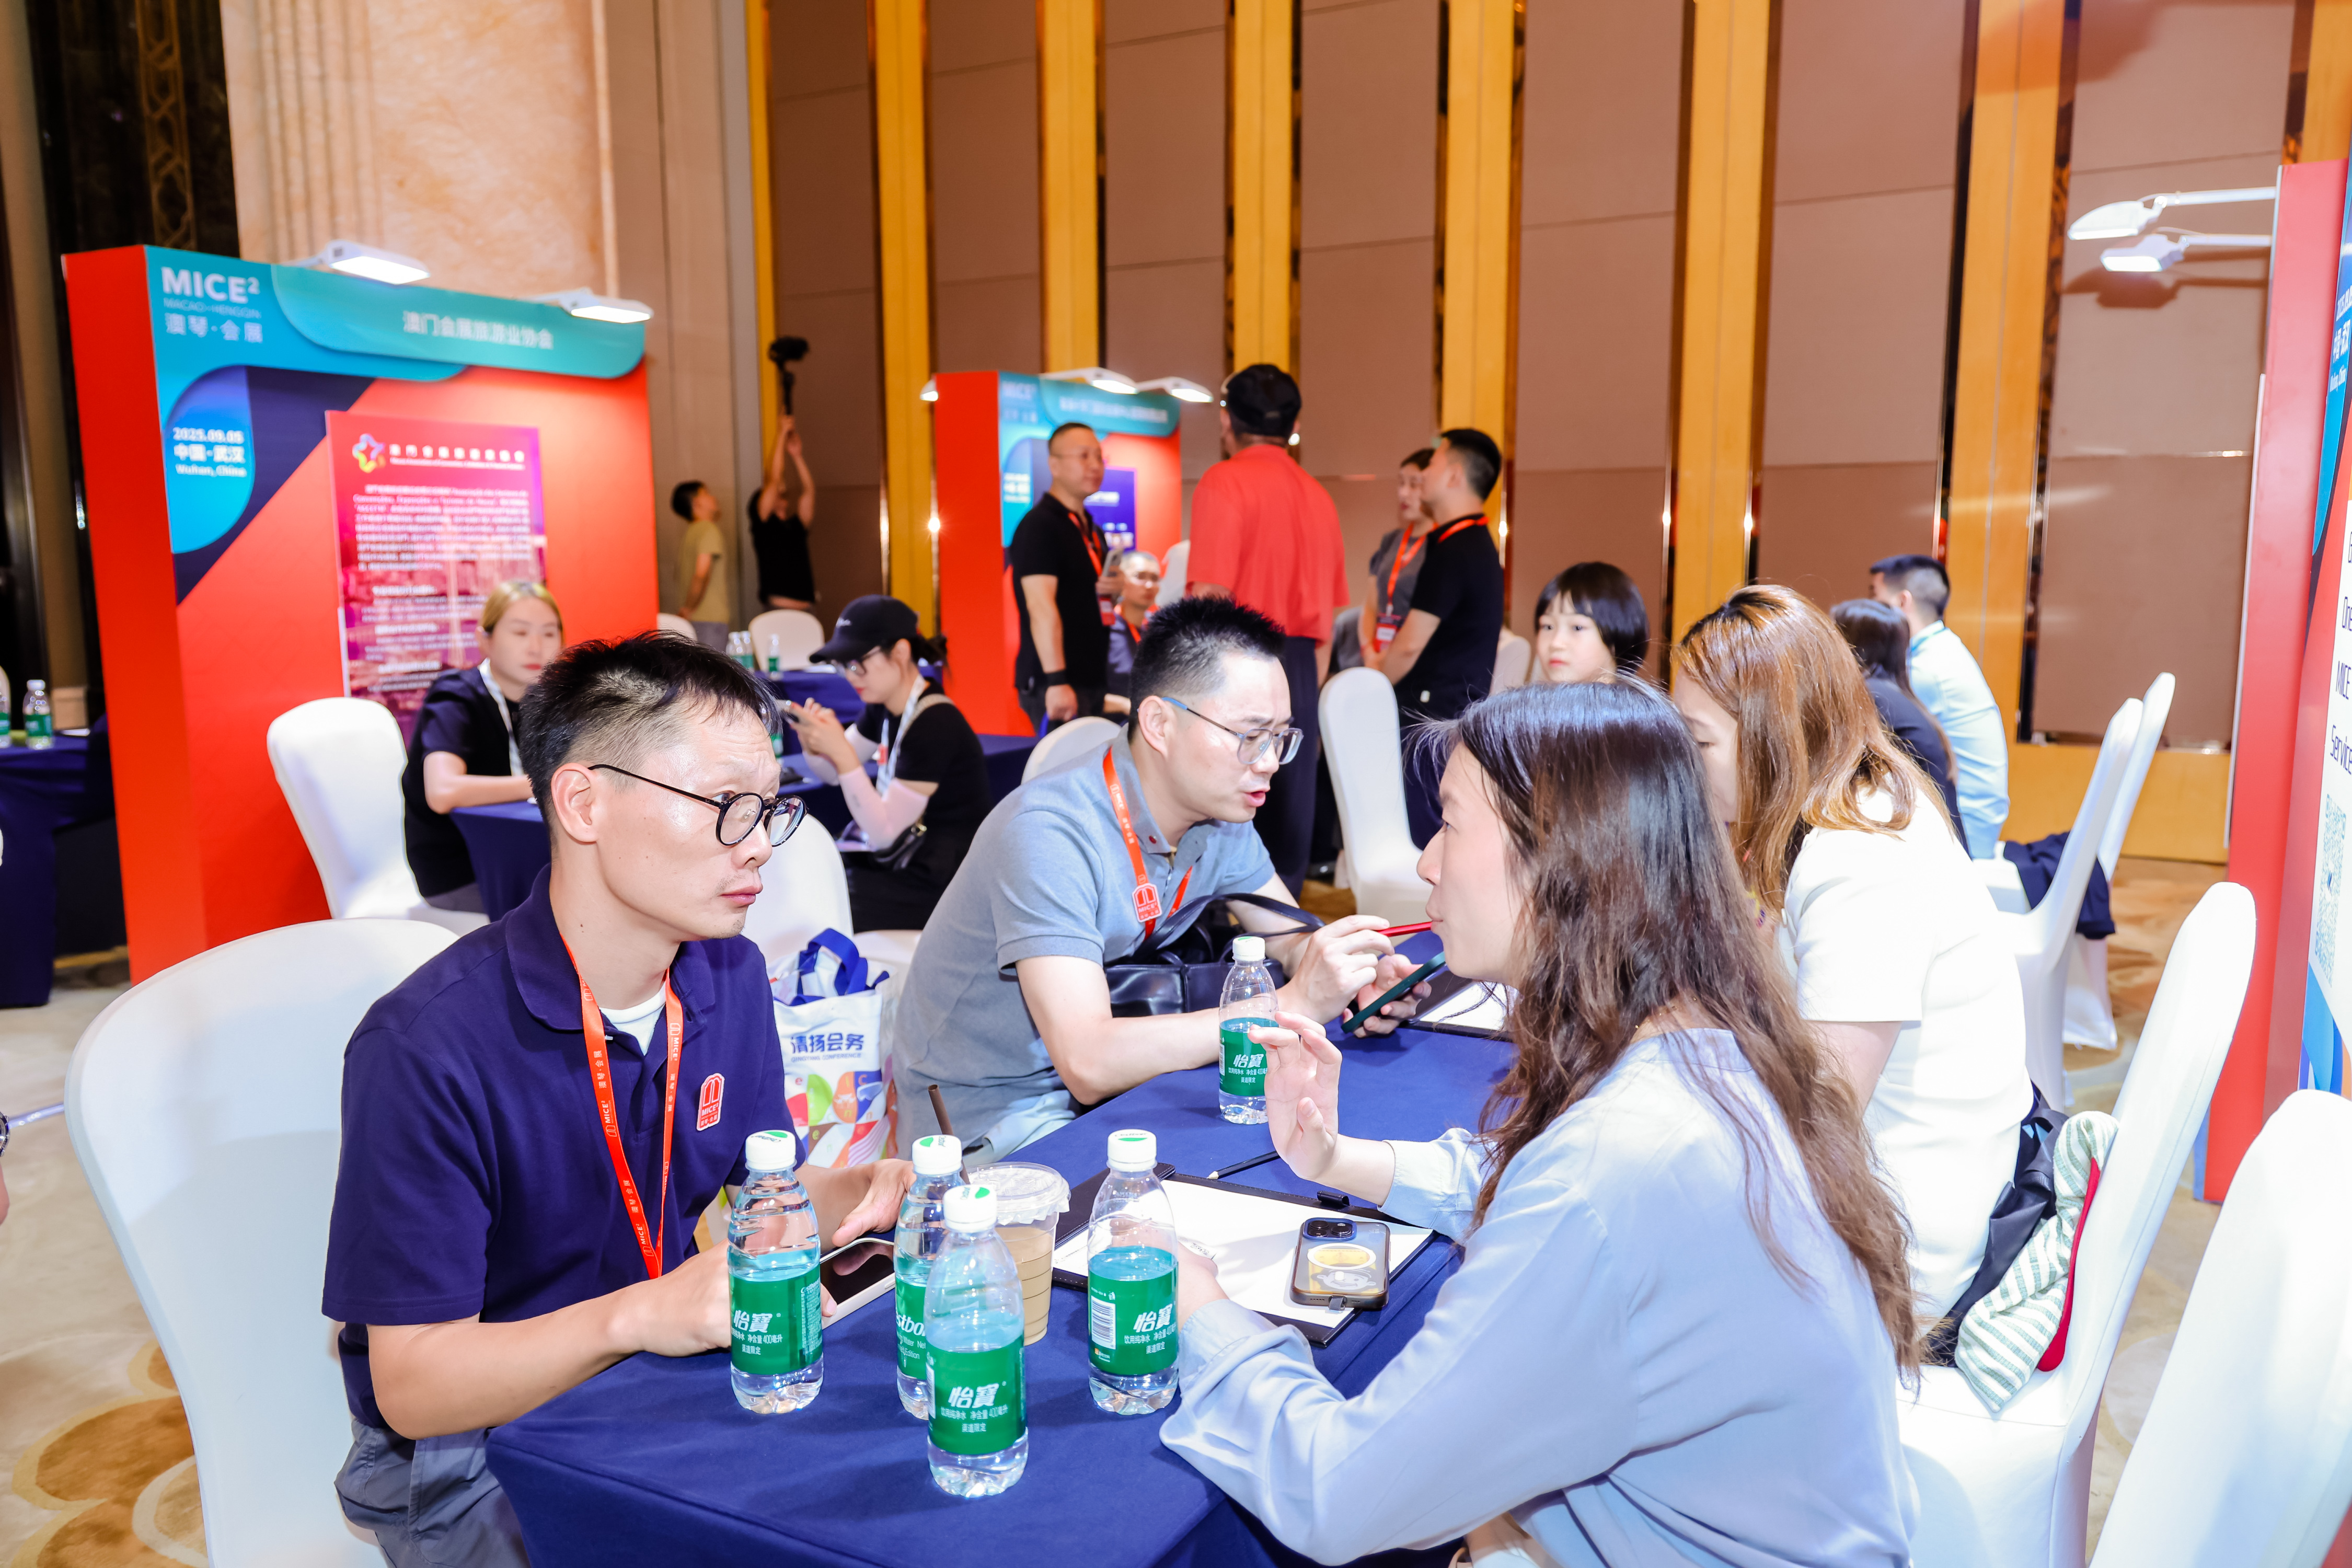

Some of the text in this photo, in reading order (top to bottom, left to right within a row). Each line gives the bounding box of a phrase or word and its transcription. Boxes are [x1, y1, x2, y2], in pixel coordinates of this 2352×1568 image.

[173, 426, 244, 444] 2025.09.05
[174, 443, 246, 464] 中国·武汉
[216, 465, 248, 477] China
[2336, 661, 2351, 700] MICE
[790, 1033, 864, 1054] 清扬会务
[1233, 1053, 1264, 1068] 怡寶
[733, 1310, 773, 1333] 怡寶
[1133, 1304, 1173, 1333] 怡寶
[948, 1382, 999, 1409] 怡寶
